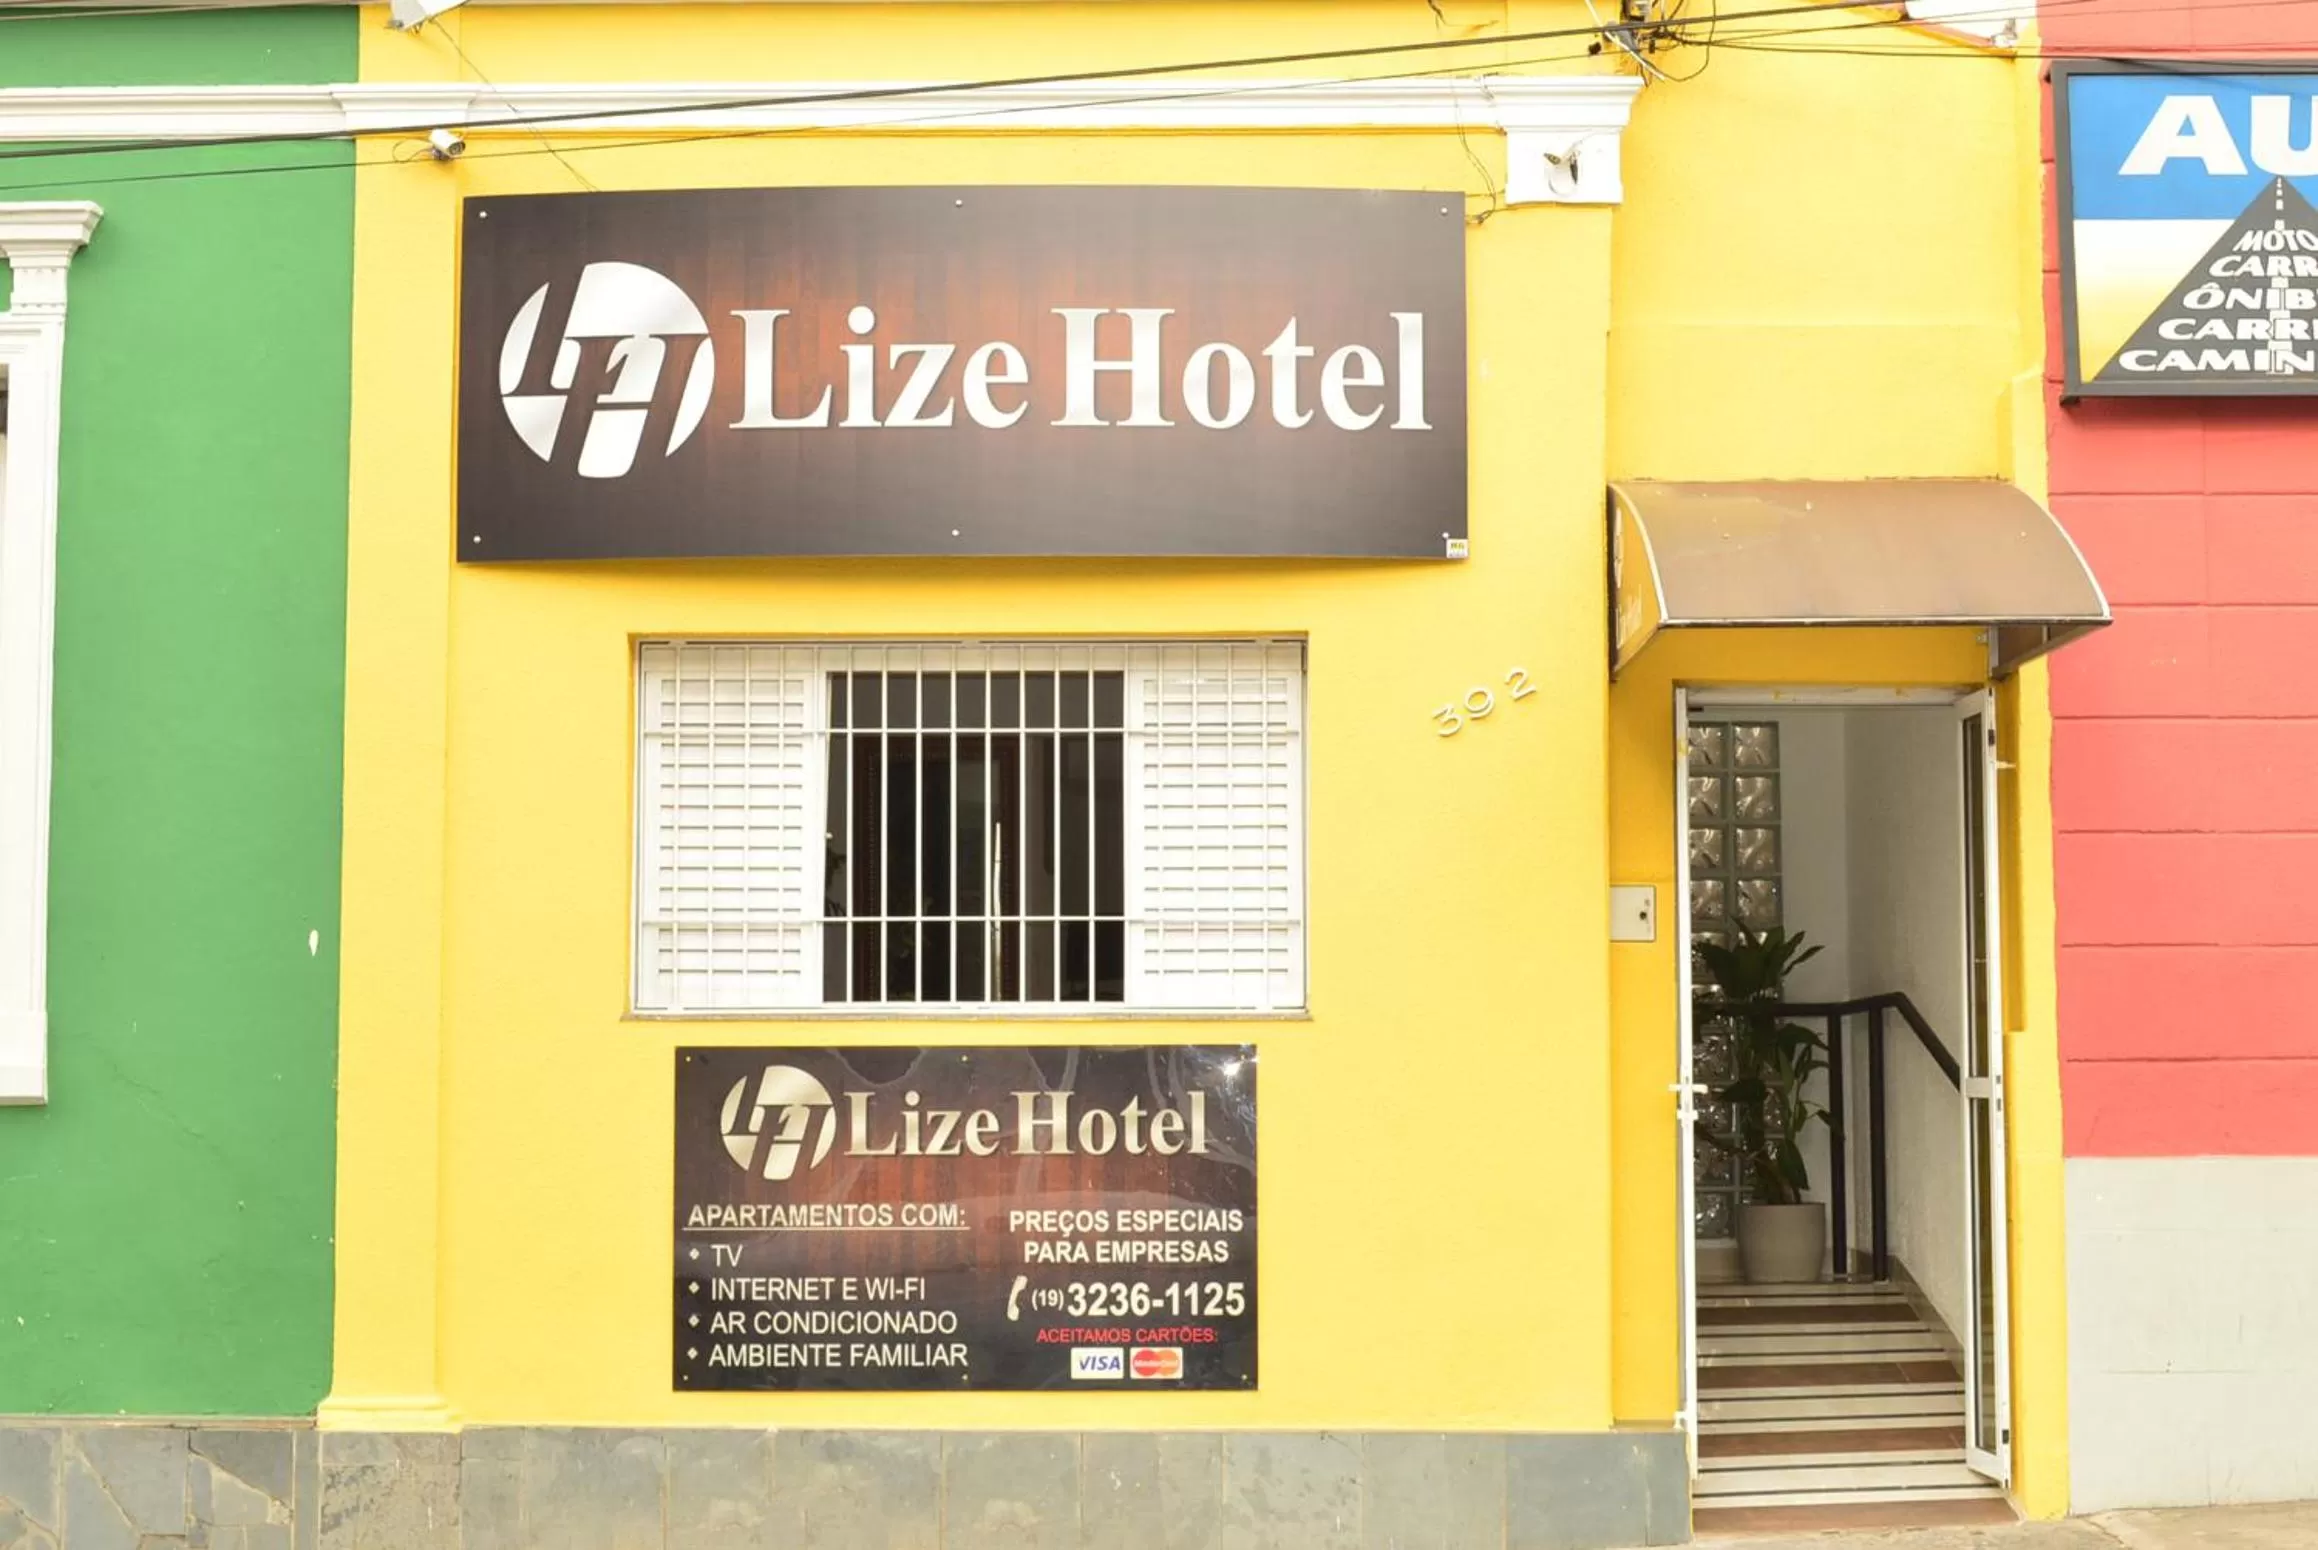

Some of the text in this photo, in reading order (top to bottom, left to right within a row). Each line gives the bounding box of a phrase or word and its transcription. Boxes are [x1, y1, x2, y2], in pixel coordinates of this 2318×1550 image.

[2182, 282, 2318, 310] ÔNIB
[2158, 318, 2318, 340] CARR
[728, 306, 1433, 431] Lize Hotel
[1432, 665, 1537, 738] 392
[843, 1090, 1210, 1156] Lize Hotel
[688, 1204, 967, 1227] APARTAMENTOS COM:
[1009, 1209, 1244, 1237] PREÇOS ESPECIAIS
[711, 1244, 743, 1267] TV
[1024, 1240, 1229, 1263] PARA EMPRESAS
[711, 1277, 925, 1300] INTERNET E WI-FI
[1031, 1282, 1245, 1317] (19) 3236-1125
[709, 1310, 957, 1335] AR CONDICIONADO
[1036, 1326, 1219, 1343] ACEITAMOS CARTÕES:
[708, 1343, 969, 1367] AMBIENTE FAMILIAR
[1079, 1355, 1122, 1371] VISA
